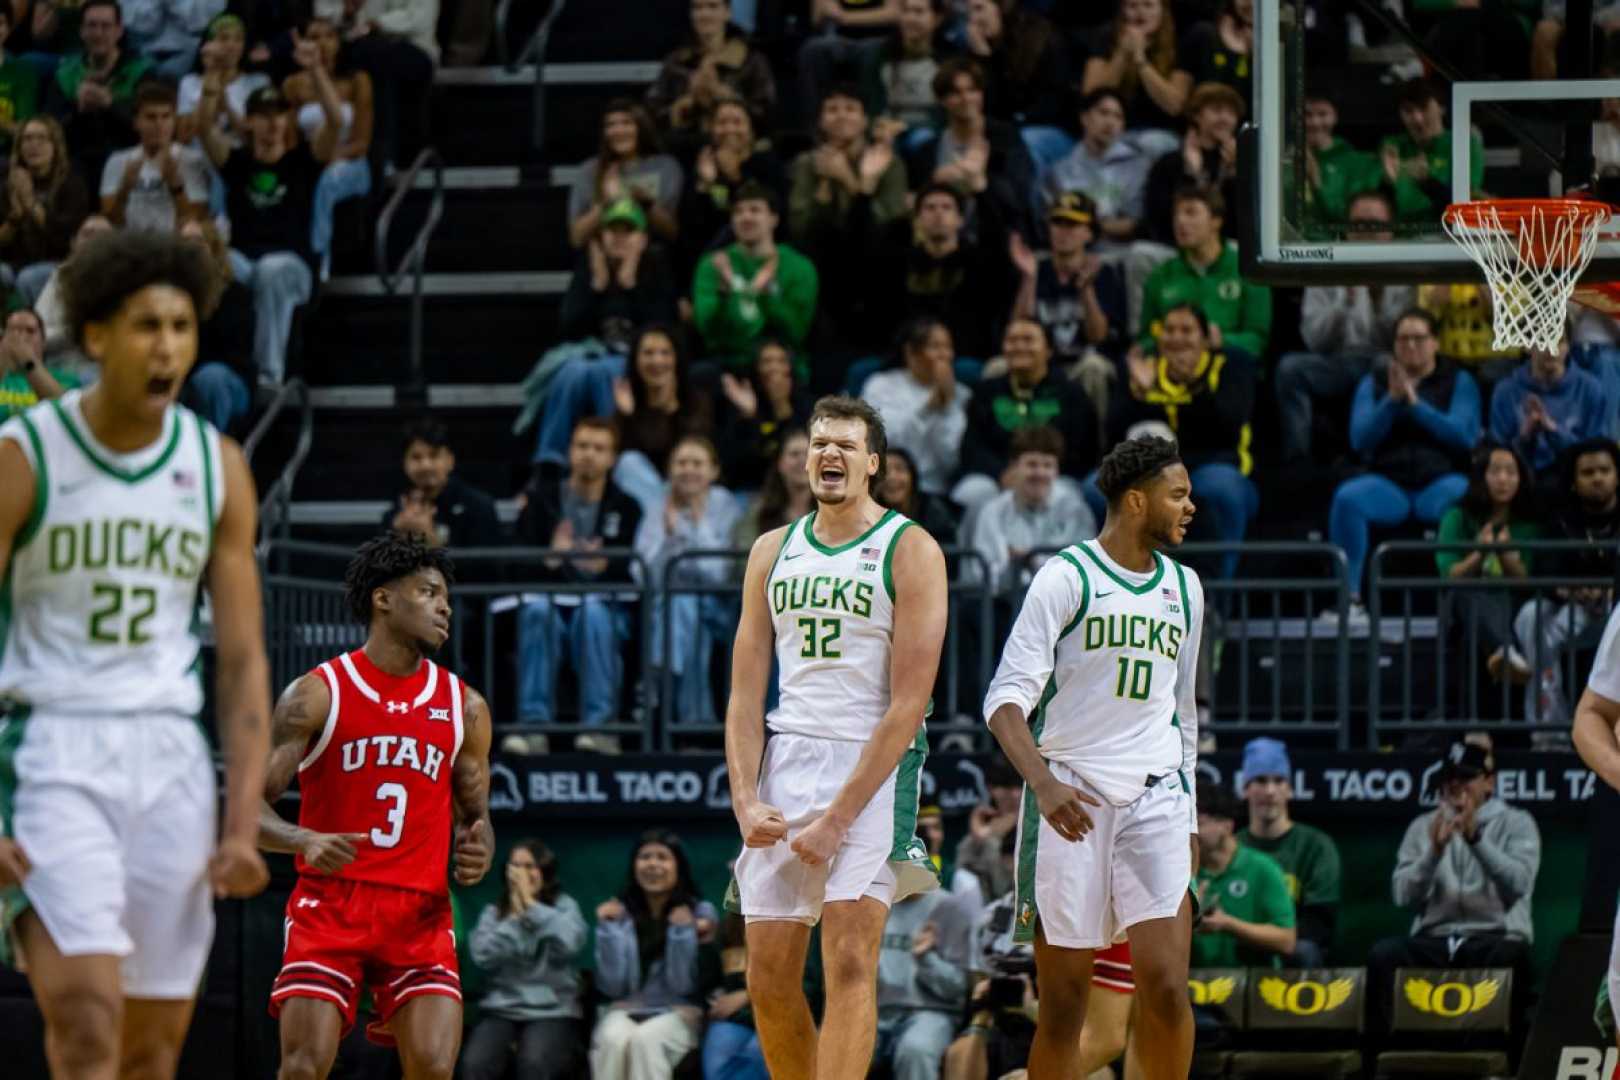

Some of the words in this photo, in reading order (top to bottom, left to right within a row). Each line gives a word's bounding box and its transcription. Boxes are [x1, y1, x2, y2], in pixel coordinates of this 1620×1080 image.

[1279, 247, 1334, 261] SPALDING
[48, 517, 203, 581] DUCKS
[88, 582, 157, 645] 22
[773, 575, 874, 620] DUCKS
[798, 617, 842, 659] 32
[1084, 614, 1183, 662] DUCKS
[1115, 656, 1154, 702] 10
[342, 735, 446, 782] UTAH
[528, 771, 608, 802] BELL
[613, 771, 703, 802] TACO
[1323, 769, 1413, 801] TACO
[1497, 769, 1556, 801] ELL
[370, 782, 409, 849] 3
